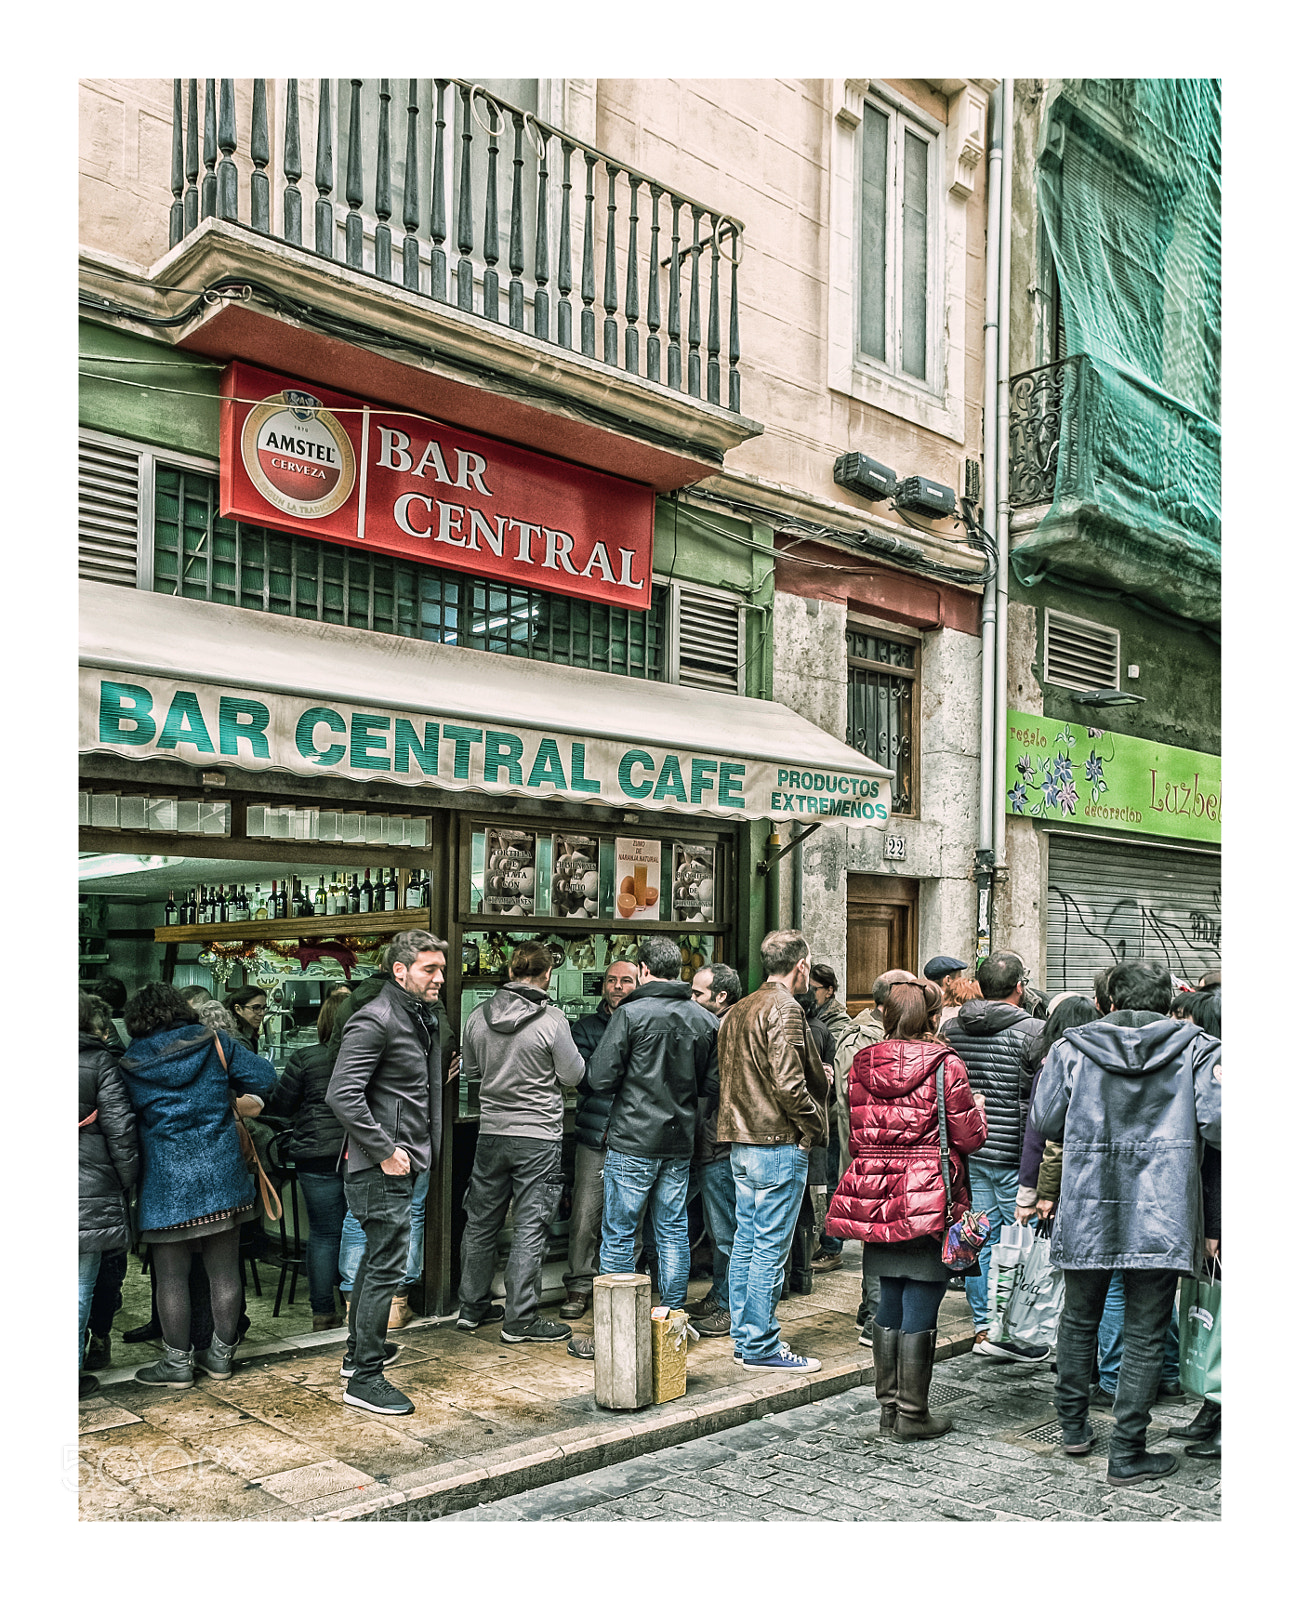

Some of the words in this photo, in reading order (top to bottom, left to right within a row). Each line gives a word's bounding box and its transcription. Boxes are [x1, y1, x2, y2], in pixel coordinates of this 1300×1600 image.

[265, 431, 335, 464] AMSTEL
[376, 424, 494, 497] BAR
[271, 458, 326, 480] CERVEZA
[393, 492, 645, 590] CENTRAL
[99, 680, 271, 759] BAR
[295, 707, 601, 794] CENTRAL
[618, 749, 746, 809] CAFE
[1009, 727, 1047, 748] regalo
[777, 768, 880, 798] PRODUCTOS
[889, 838, 904, 856] 22
